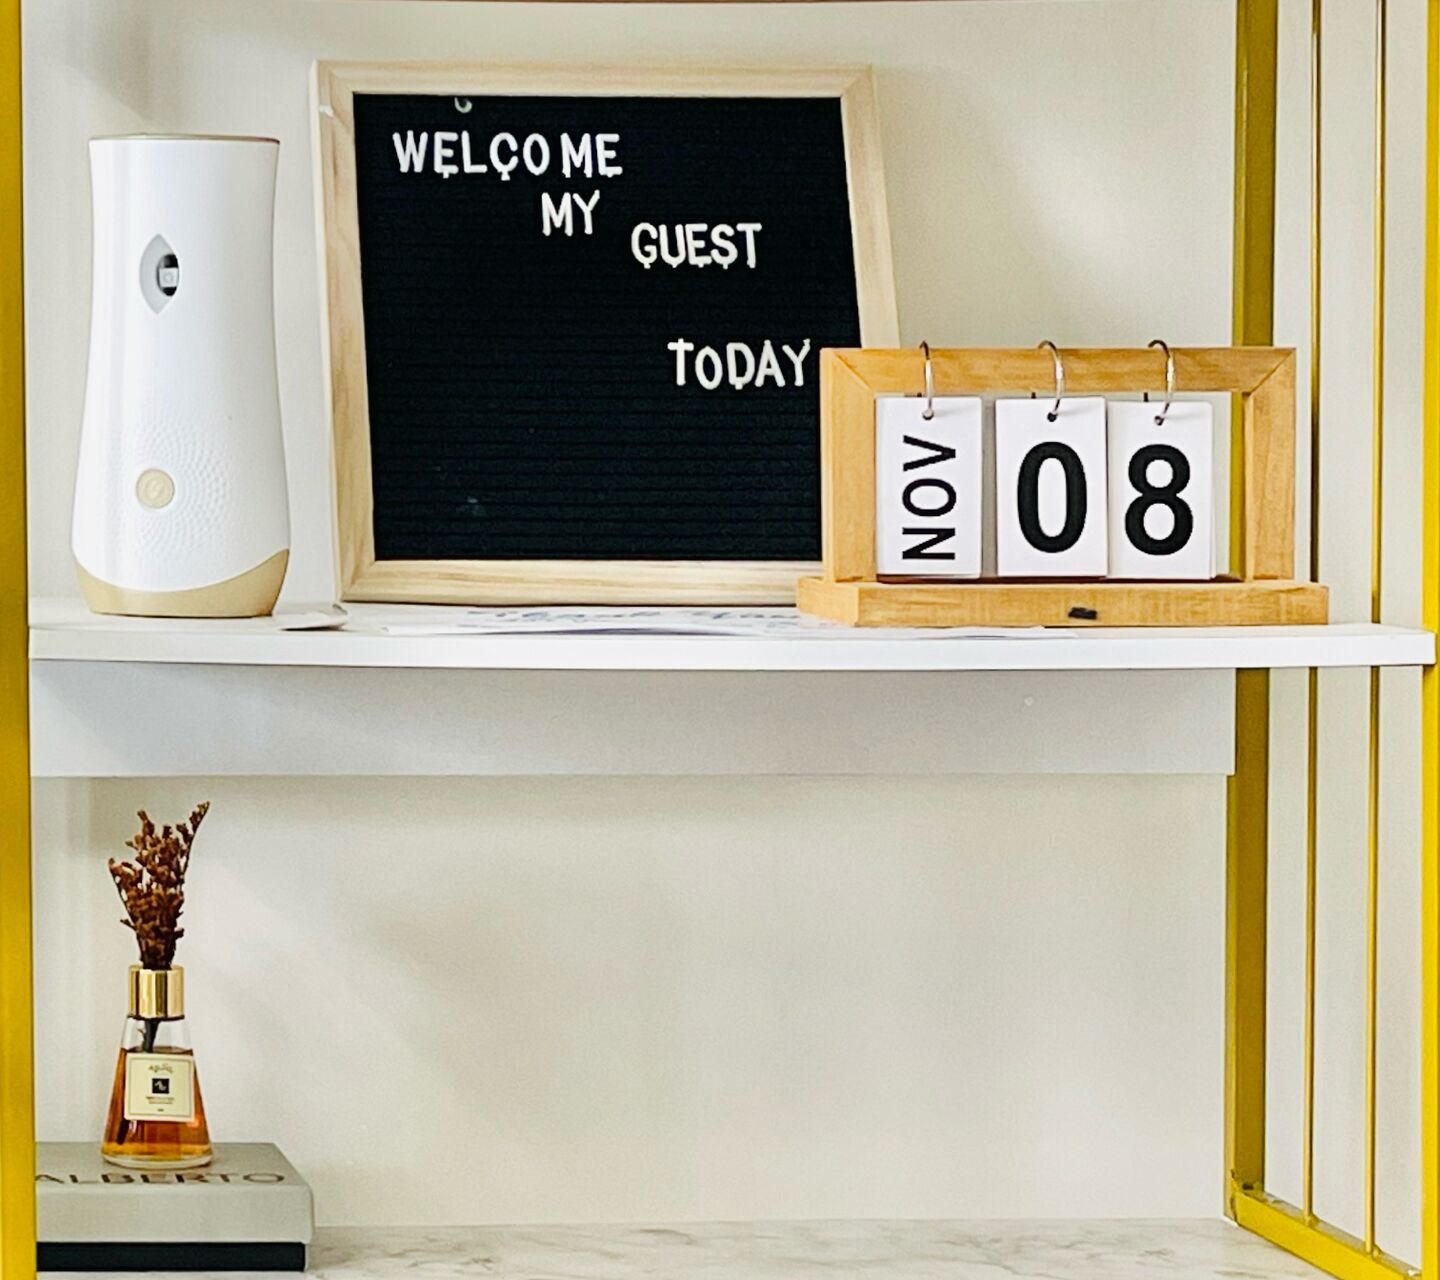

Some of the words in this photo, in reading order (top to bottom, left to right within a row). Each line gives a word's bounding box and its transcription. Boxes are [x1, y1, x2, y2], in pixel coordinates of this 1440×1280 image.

[393, 131, 622, 181] WELCOME
[542, 190, 600, 236] MY
[632, 223, 762, 269] GUEST
[668, 339, 810, 389] TODAY
[902, 435, 956, 560] NOV
